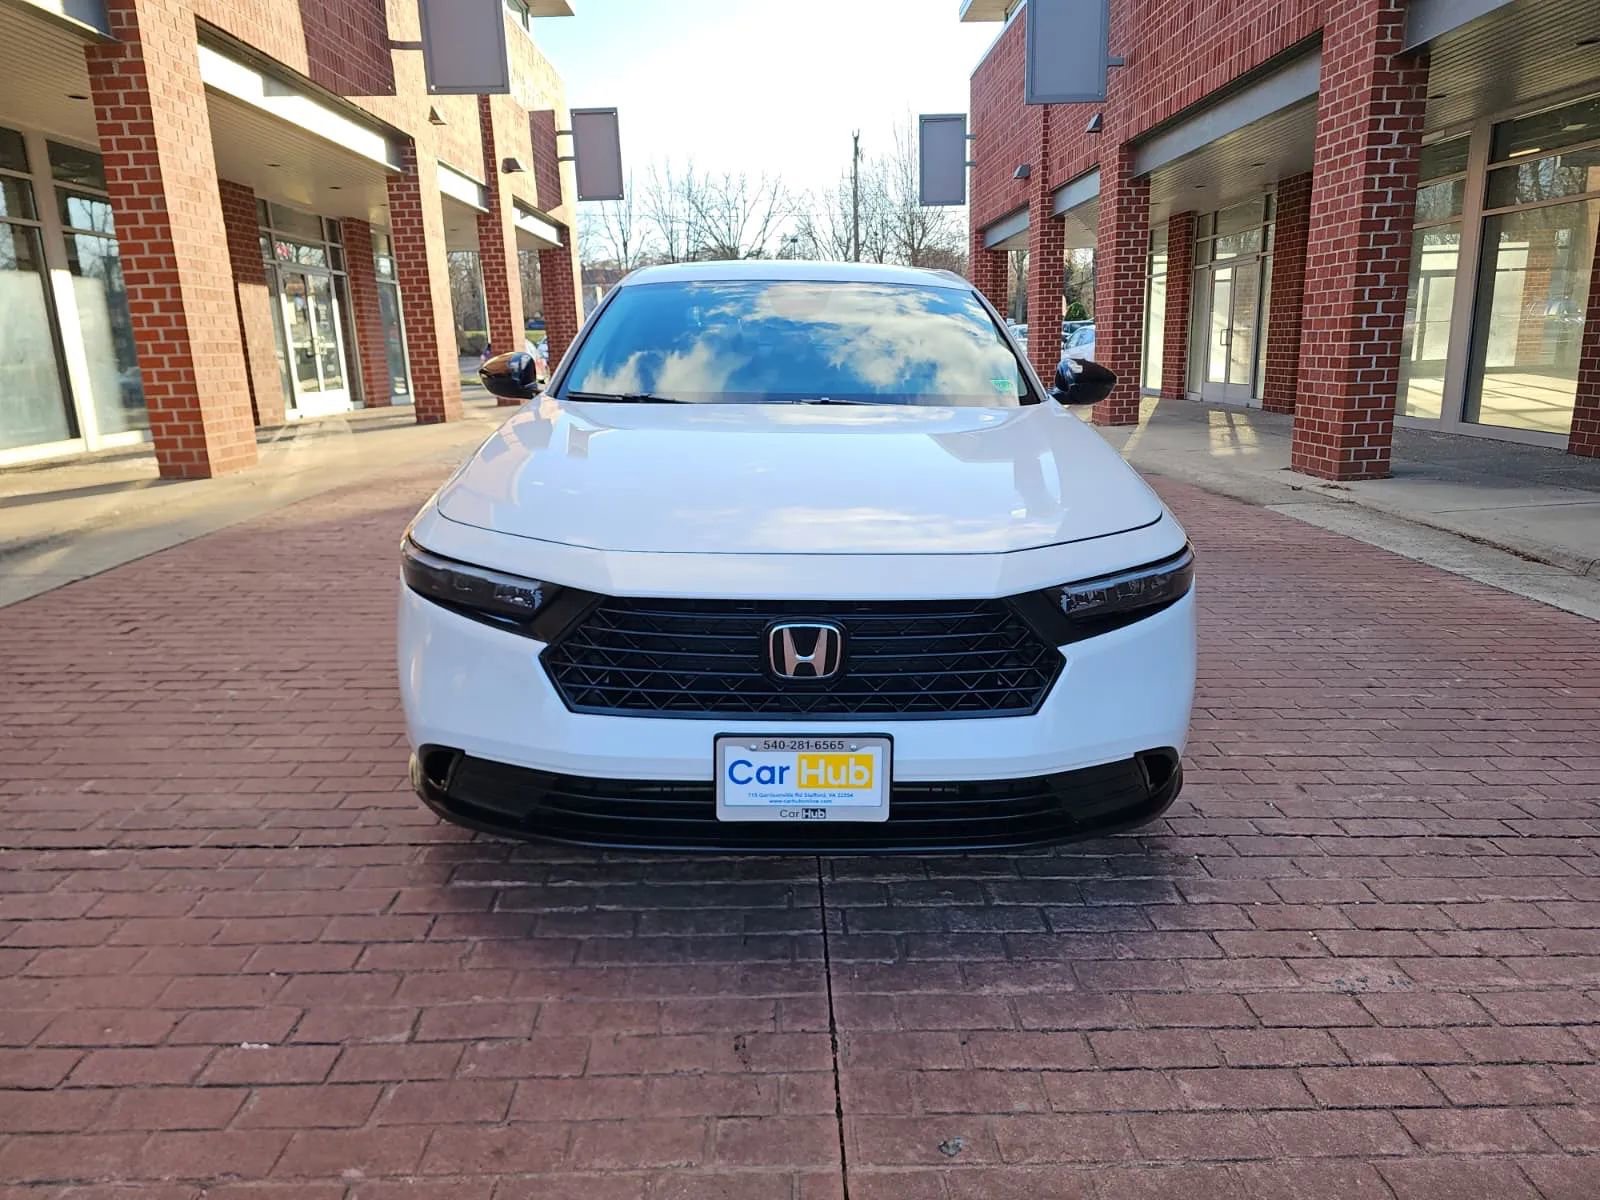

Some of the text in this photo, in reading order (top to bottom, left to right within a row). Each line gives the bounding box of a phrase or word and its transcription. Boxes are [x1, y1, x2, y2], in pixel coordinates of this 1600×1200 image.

[763, 740, 845, 750] 540-281-6565
[728, 758, 870, 786] Car Hub
[780, 808, 825, 818] Car Hub
